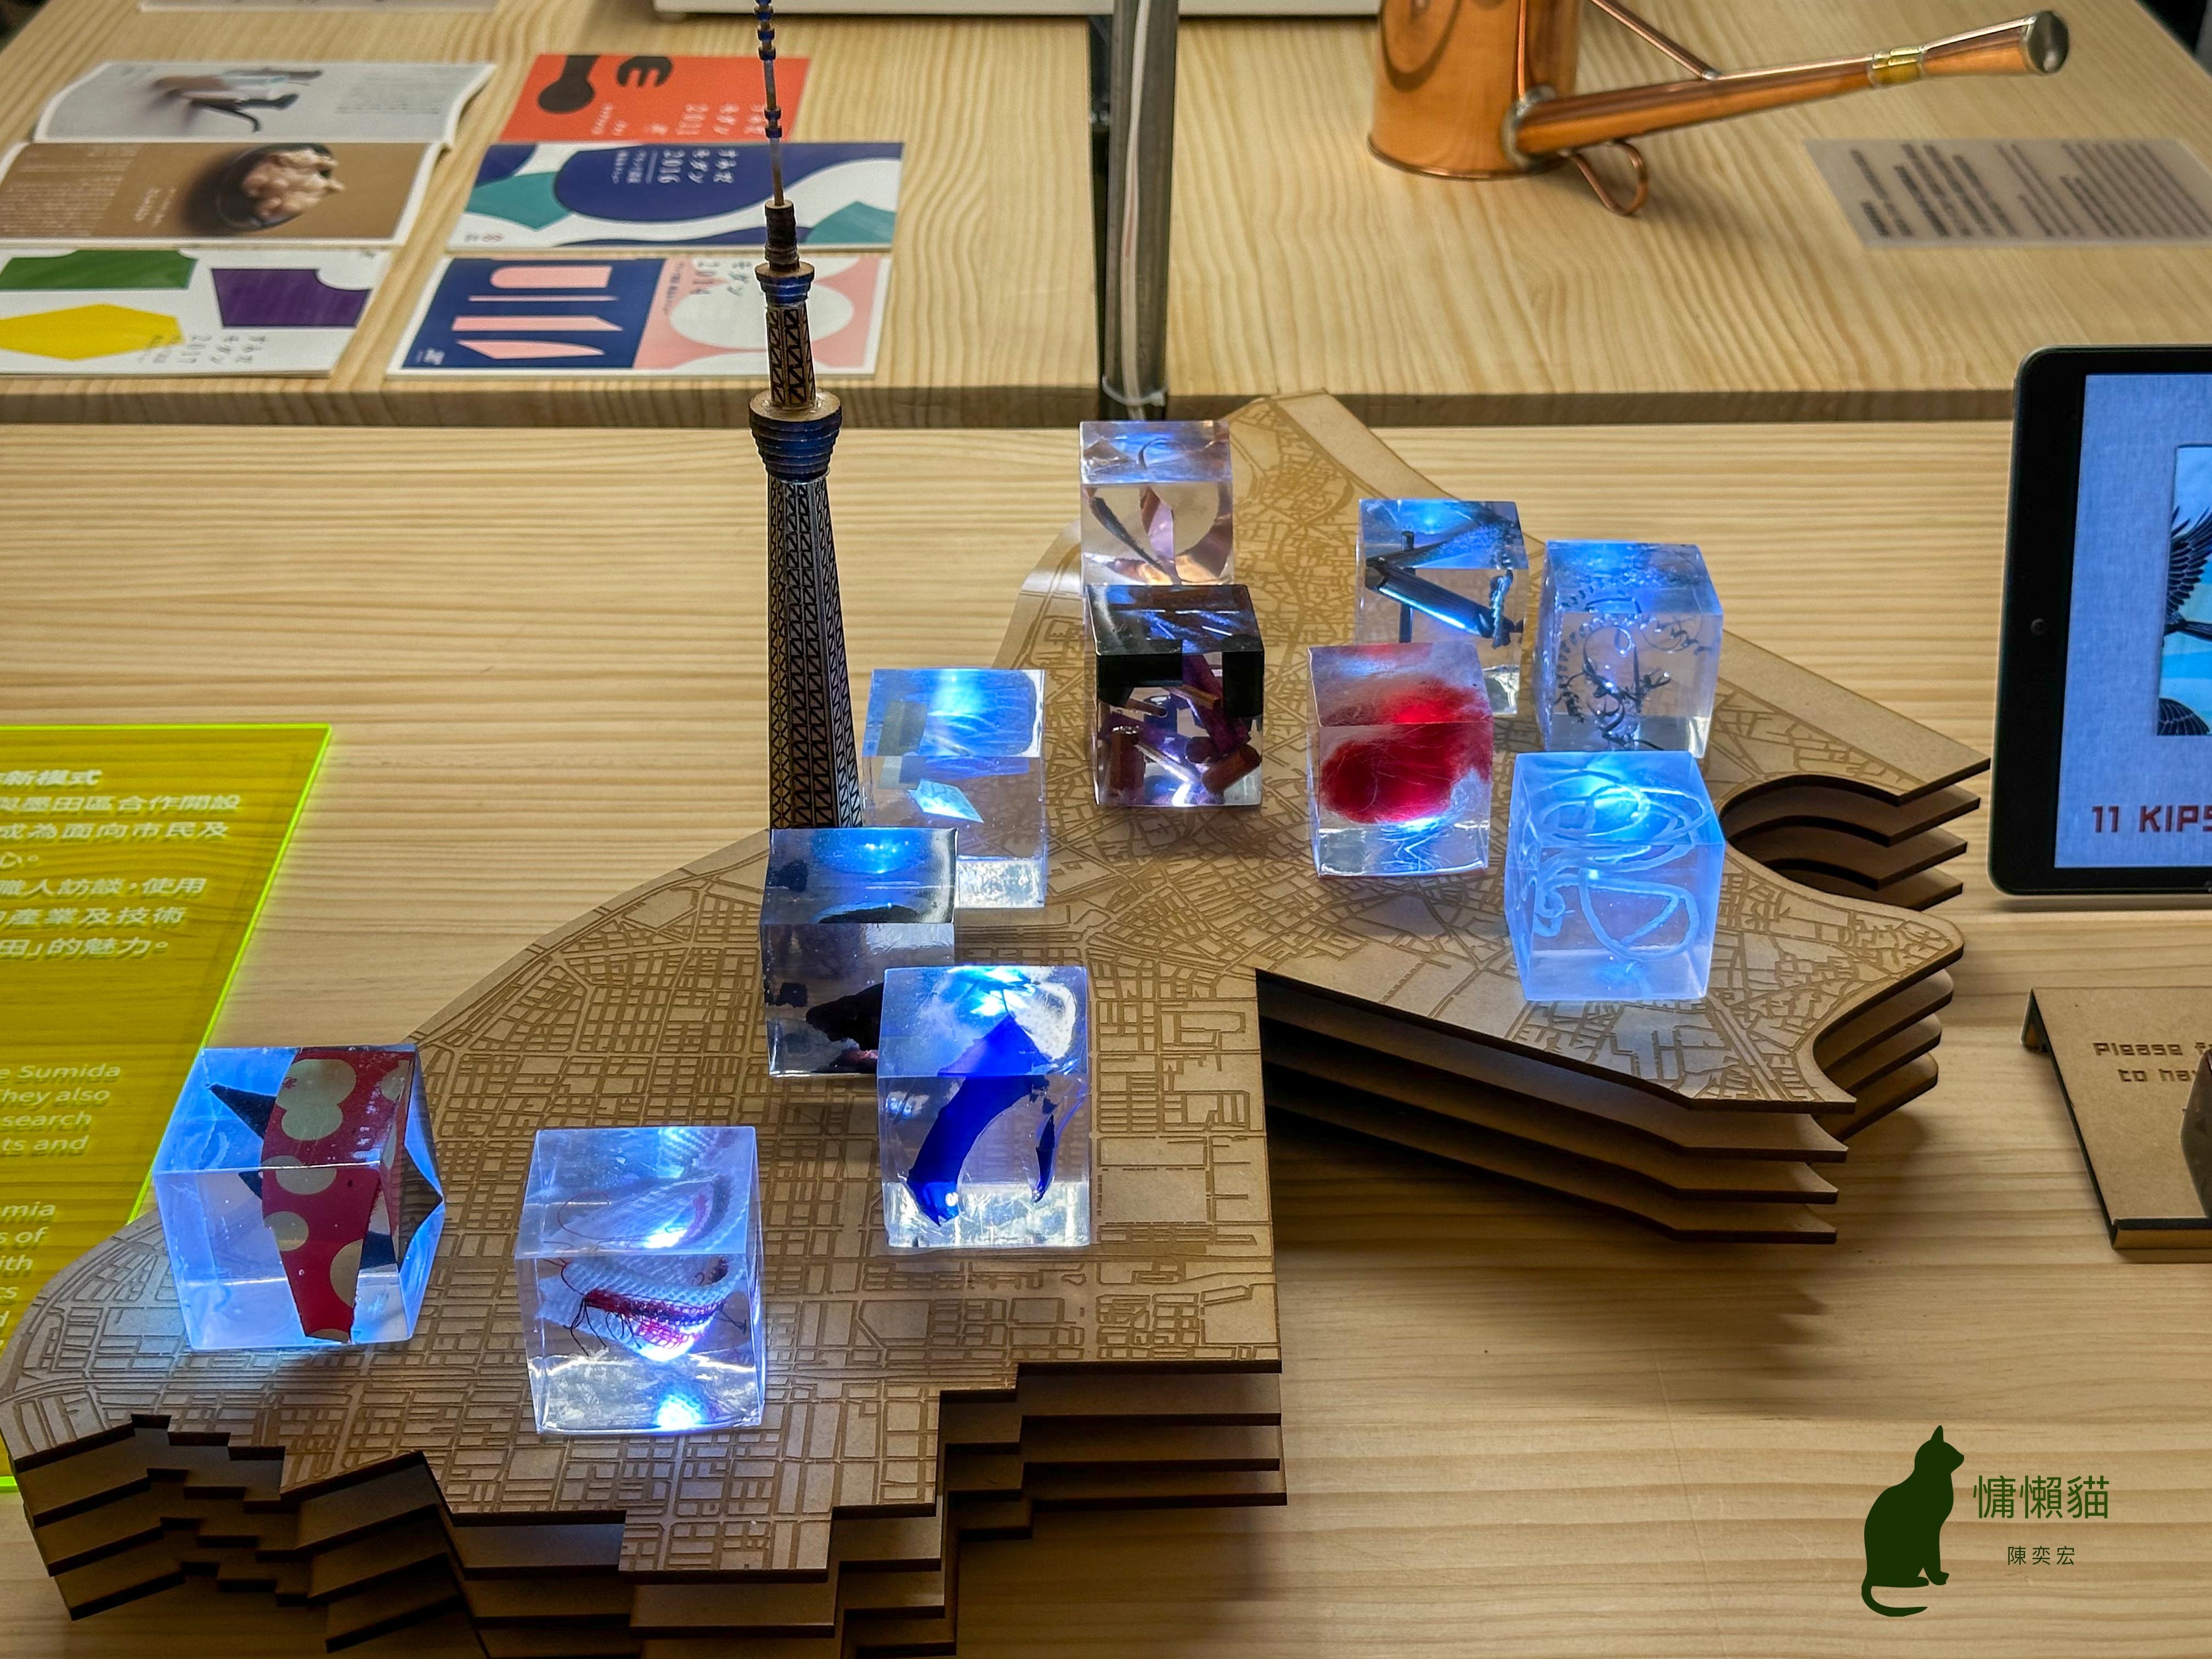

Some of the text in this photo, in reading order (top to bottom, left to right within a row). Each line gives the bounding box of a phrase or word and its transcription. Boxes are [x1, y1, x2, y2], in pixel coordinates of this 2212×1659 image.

[658, 149, 685, 184] 2016
[2092, 805, 2119, 833] 11
[2092, 1042, 2183, 1056] Please
[17, 1063, 121, 1079] Sumida
[2117, 1069, 2197, 1082] to ha
[55, 1086, 111, 1102] also
[33, 1134, 90, 1150] and
[15, 1226, 49, 1243] of
